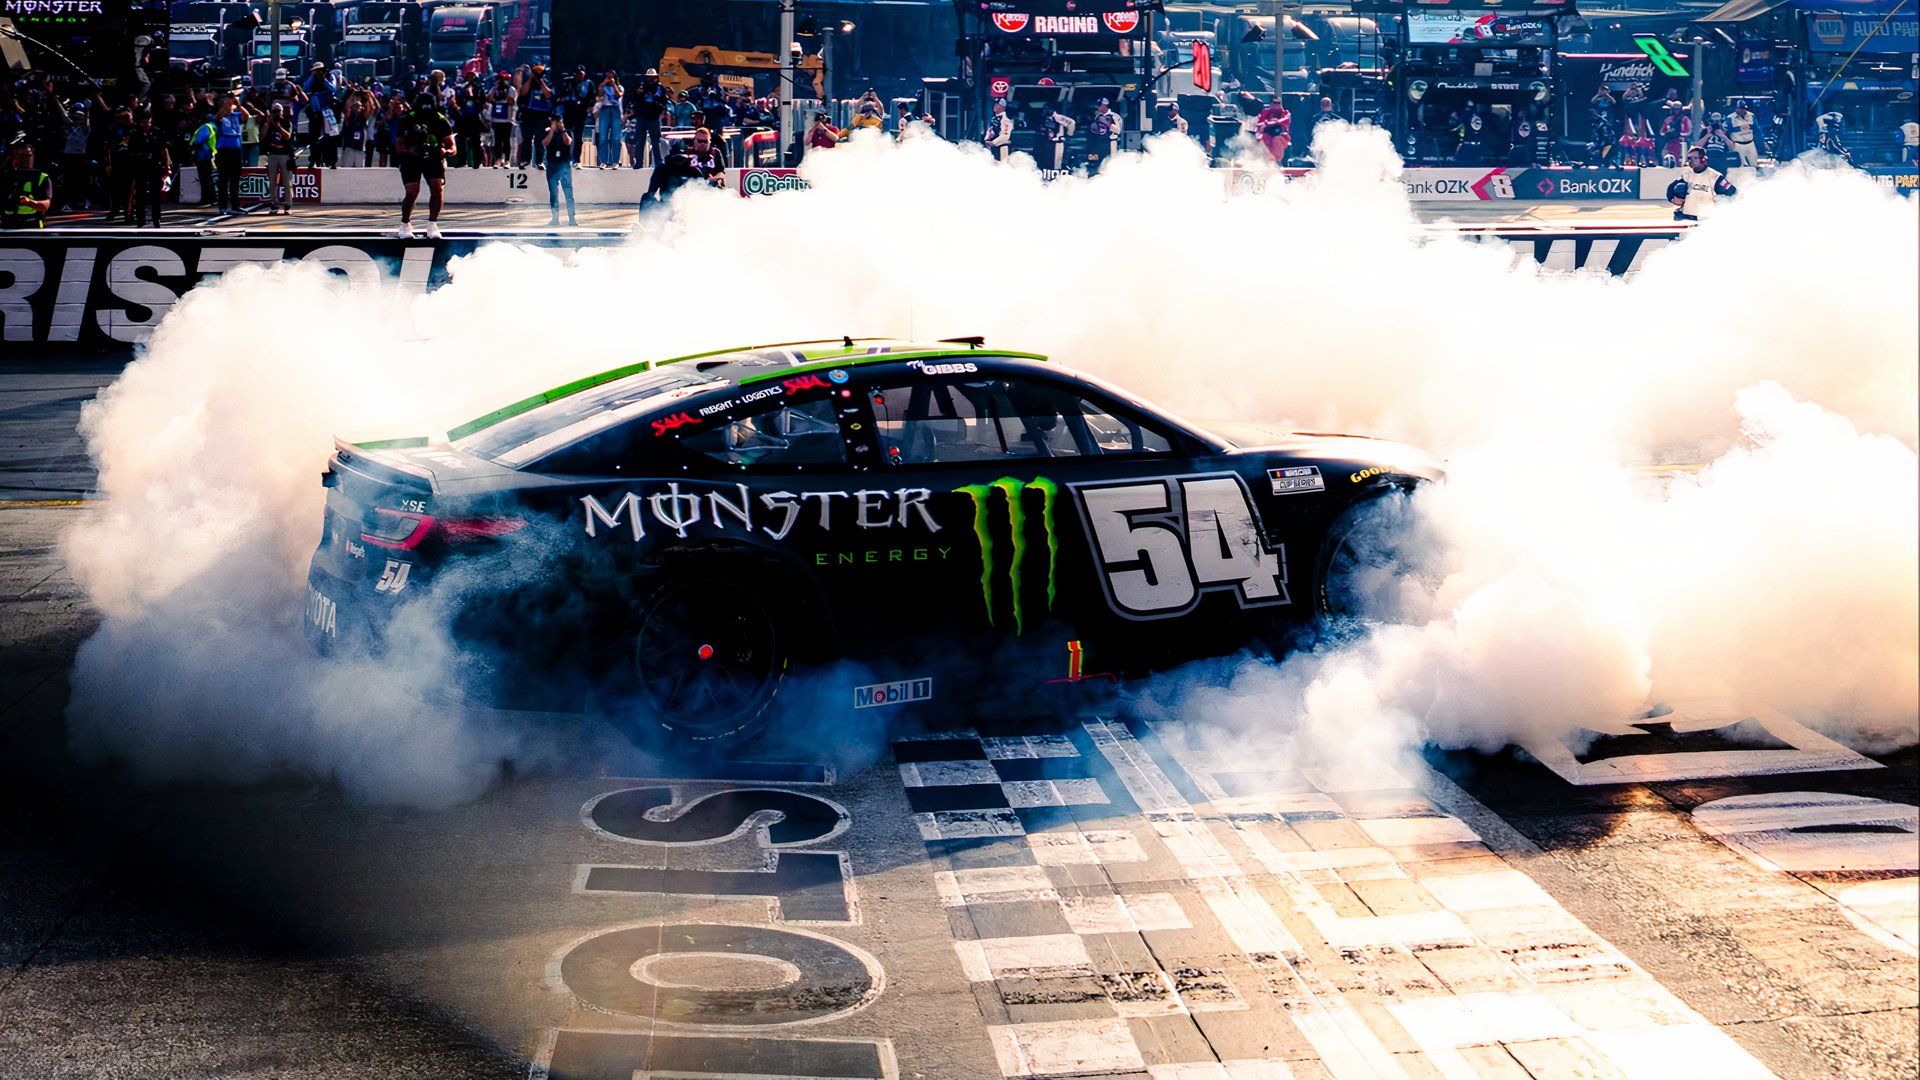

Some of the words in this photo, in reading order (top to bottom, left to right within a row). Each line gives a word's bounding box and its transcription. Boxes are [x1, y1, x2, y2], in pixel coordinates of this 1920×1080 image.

[5, 0, 103, 14] MONSTER
[291, 174, 316, 186] UTO
[506, 173, 528, 189] 12
[1434, 179, 1470, 194] OZK
[1491, 174, 1515, 199] 8
[1559, 178, 1597, 194] Bank
[1597, 178, 1632, 194] OZK
[279, 186, 319, 198] PRTS
[921, 362, 978, 376] GIBBS
[740, 385, 783, 404] LOGISTICS
[400, 499, 427, 513] XSE
[1068, 472, 1291, 619] 54
[816, 546, 953, 567] ENERGY
[375, 559, 412, 595] 54
[856, 682, 908, 707] Mobil
